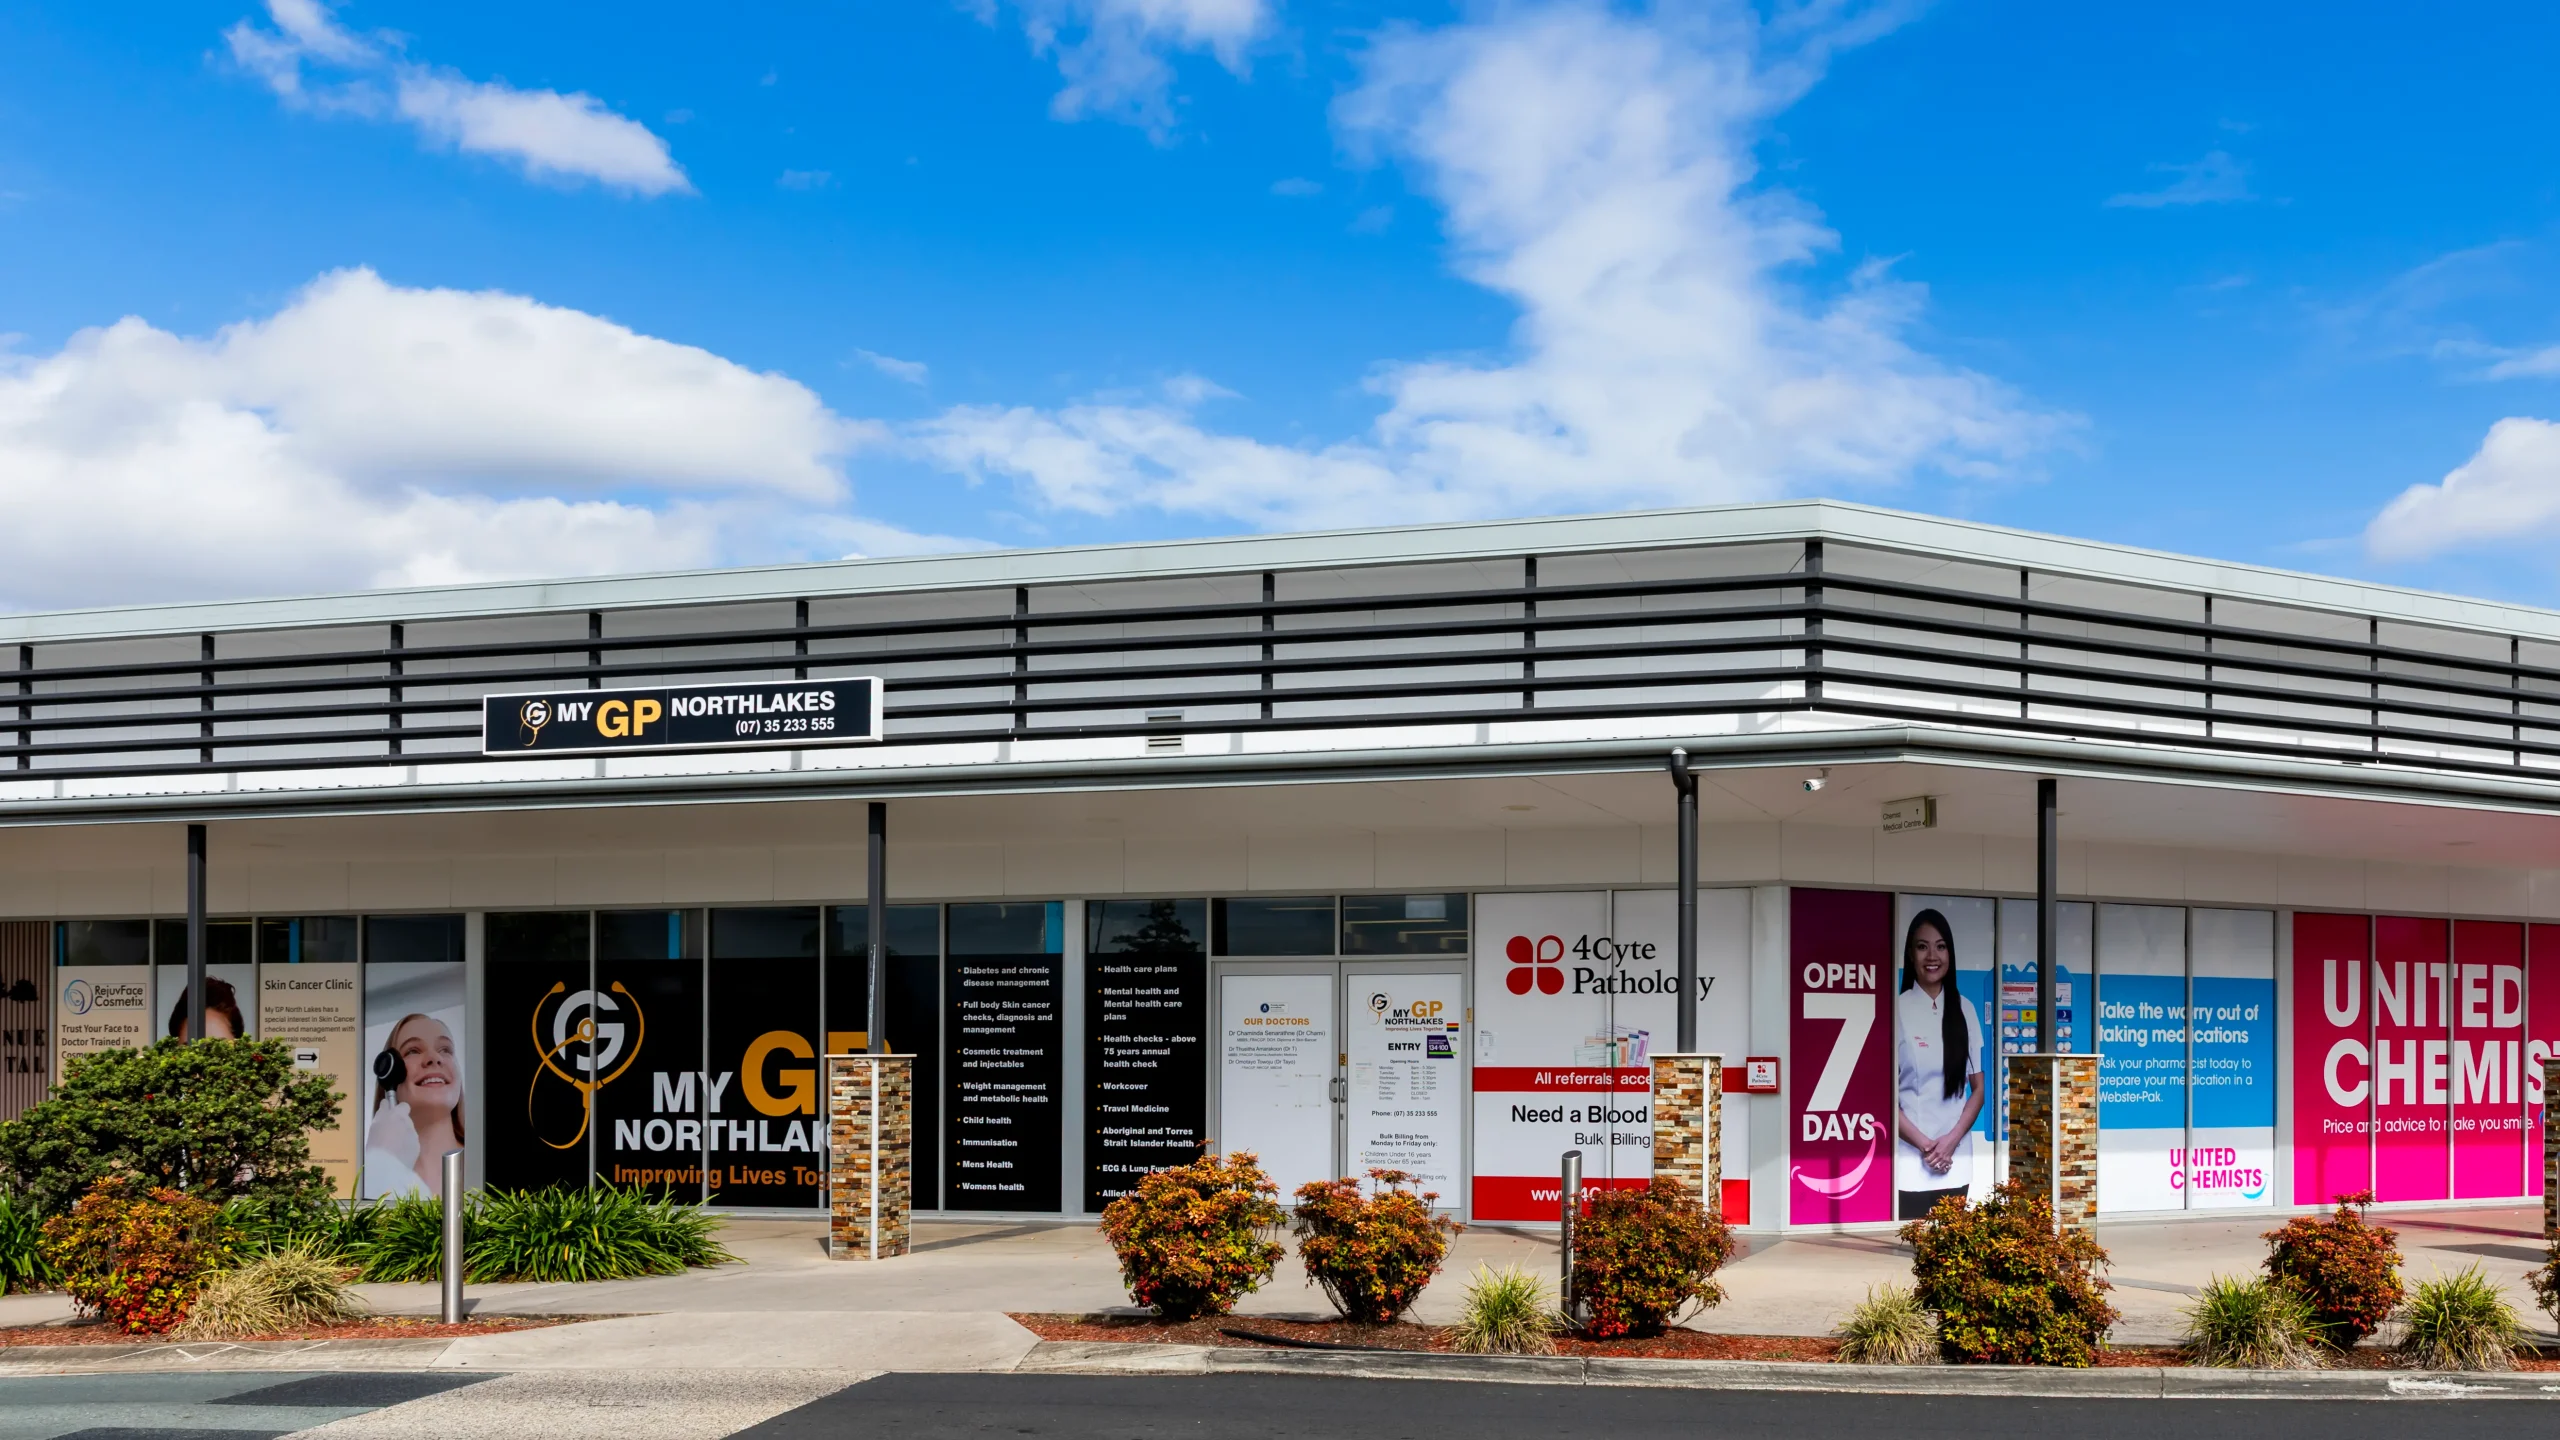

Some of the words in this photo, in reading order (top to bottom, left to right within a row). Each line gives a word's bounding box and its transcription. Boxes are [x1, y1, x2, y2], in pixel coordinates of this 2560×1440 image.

[557, 702, 593, 722] MY
[596, 699, 662, 738] GP
[671, 691, 835, 717] NORTHLAKES
[735, 719, 760, 736] (07)
[764, 718, 780, 733] 35
[784, 717, 808, 732] 233
[811, 717, 835, 731] 555
[1883, 821, 1903, 831] Medical
[1904, 820, 1921, 828] Centre
[1572, 934, 1656, 967] 4Cyte
[1019, 966, 1050, 974] chronic
[1154, 965, 1178, 974] plans
[1803, 962, 1876, 990] OPEN
[265, 980, 286, 990] Skin
[289, 980, 323, 990] Cancer
[325, 979, 353, 990] Clinic
[996, 979, 1050, 987] management
[1572, 968, 1715, 1001] Patholoy
[95, 985, 143, 998] RejuvFace
[1135, 987, 1161, 995] health
[1163, 987, 1179, 995] and
[2323, 959, 2522, 1028] UNITED
[95, 996, 144, 1007] Cosmetix
[980, 1001, 1000, 1010] body
[1104, 1000, 1133, 1008] Mental
[1135, 1000, 1161, 1008] health
[1393, 1009, 1410, 1018] MY
[1411, 1000, 1443, 1018] GP
[2099, 1001, 2135, 1019] Take
[2139, 1002, 2163, 1019] the
[2216, 1003, 2241, 1021] out
[2244, 1004, 2259, 1021] of
[963, 1014, 994, 1022] checks,
[996, 1013, 1035, 1022] diagnosis
[1037, 1013, 1053, 1021] and
[1104, 1013, 1127, 1022] plans
[1243, 1018, 1263, 1026] OUR
[1265, 1018, 1310, 1026] DOCTORS
[62, 1025, 82, 1033] Trust
[84, 1025, 102, 1033] Your
[104, 1024, 122, 1033] Face
[123, 1025, 132, 1033] to
[963, 1026, 1016, 1034] management
[62, 1038, 88, 1046] Doctor
[90, 1037, 120, 1046] Trained
[122, 1037, 131, 1046] in
[2099, 1025, 2148, 1047] taking
[1002, 1048, 1043, 1056] treatment
[1117, 1048, 1140, 1056] years
[1142, 1047, 1170, 1055] annual
[1388, 1043, 1421, 1051] ENTRY
[1803, 993, 1876, 1111] 7
[962, 1060, 978, 1068] and
[980, 1060, 1024, 1069] injectables
[1103, 1060, 1130, 1068] health
[1132, 1060, 1158, 1068] check
[2099, 1057, 2116, 1069] Ask
[2119, 1059, 2142, 1071] your
[2209, 1058, 2239, 1071] today
[2241, 1058, 2252, 1069] to
[1534, 1072, 1551, 1085] All
[1555, 1072, 1614, 1085] referrals
[2099, 1075, 2141, 1088] prepare
[2144, 1076, 2167, 1088] your
[2233, 1074, 2242, 1086] in
[2245, 1077, 2253, 1086] a
[963, 1082, 992, 1091] Weight
[993, 1083, 1046, 1091] management
[1103, 1082, 1148, 1090] Workcover
[652, 1071, 733, 1113] MY
[2099, 1090, 2164, 1102] Webster-Pak.
[1022, 1095, 1049, 1103] health
[1512, 1104, 1563, 1123] Need
[1570, 1109, 1581, 1123] a
[1588, 1106, 1647, 1123] Blood
[1803, 1113, 1875, 1142] DAYS
[2323, 1119, 2353, 1134] Price
[2384, 1117, 2426, 1133] advice
[2428, 1118, 2441, 1132] to
[2479, 1118, 2500, 1133] you
[2503, 1115, 2535, 1130] smie.
[615, 1119, 832, 1152] NORTHLAK
[1102, 1127, 1145, 1136] Aboriginal
[1147, 1127, 1163, 1135] and
[1165, 1127, 1194, 1135] Torres
[963, 1138, 1018, 1146] Immunisation
[1103, 1139, 1127, 1147] Strait
[1130, 1139, 1165, 1147] Islander
[1166, 1140, 1195, 1148] Health
[1575, 1132, 1604, 1146] Bulk
[1612, 1133, 1651, 1148] Billing
[2170, 1147, 2236, 1167] UNITED
[962, 1160, 984, 1168] Mens
[1102, 1164, 1120, 1172] ECG
[1129, 1165, 1149, 1174] Lung
[614, 1164, 722, 1188] Improving
[730, 1165, 786, 1185] Lives
[2170, 1169, 2262, 1190] CHEMISTS
[962, 1182, 997, 1190] Womens
[998, 1183, 1025, 1191] health
